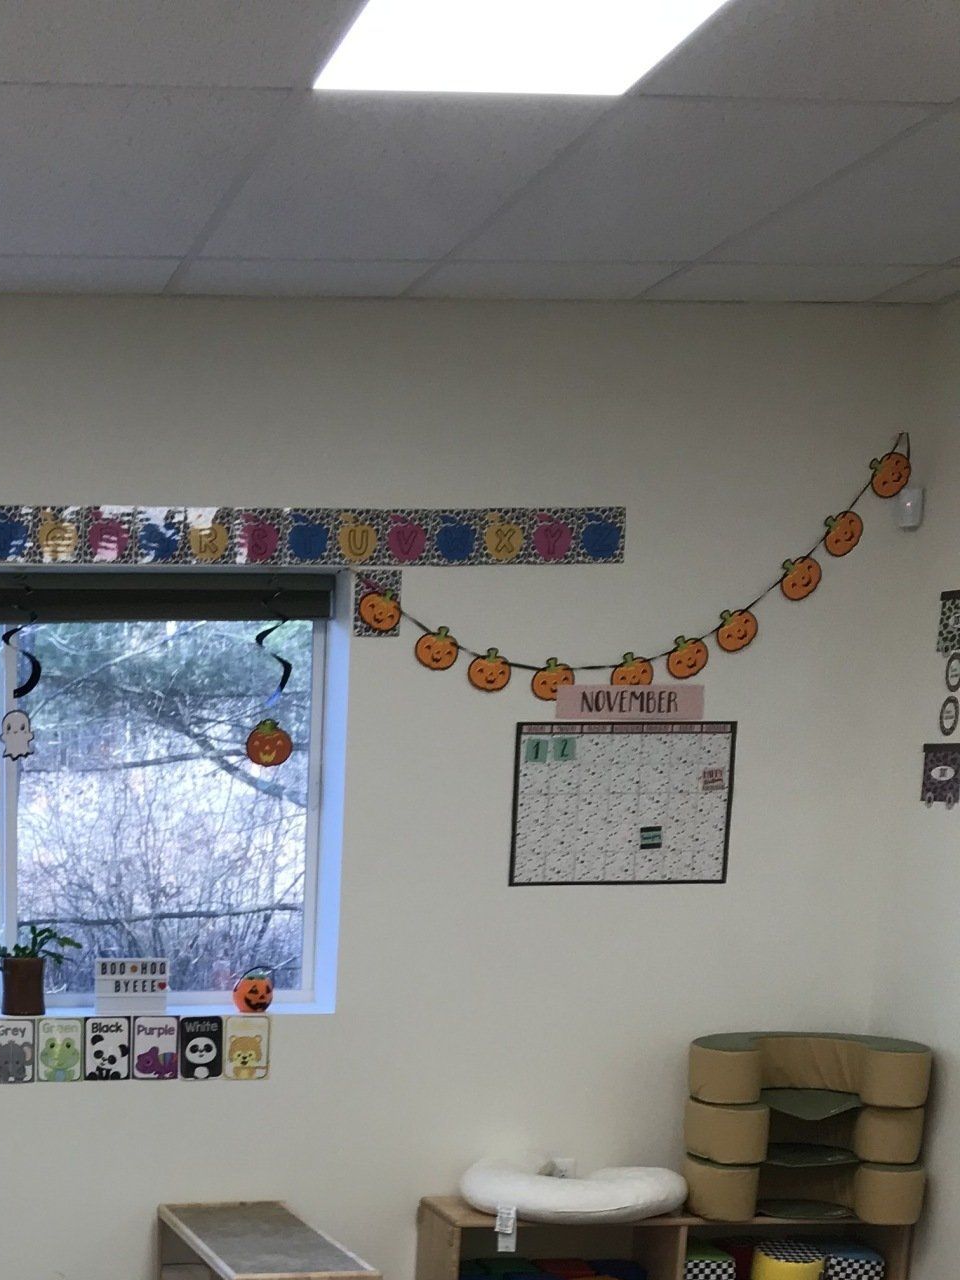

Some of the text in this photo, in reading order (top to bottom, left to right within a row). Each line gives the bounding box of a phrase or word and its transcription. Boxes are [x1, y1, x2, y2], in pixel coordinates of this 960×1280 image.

[198, 527, 218, 554] R
[251, 529, 268, 556] S
[348, 530, 368, 555] U
[397, 530, 417, 554] V
[494, 529, 515, 552] X
[543, 530, 562, 553] Y
[580, 690, 679, 713] NOVEMBER
[532, 739, 569, 760] 1 2
[100, 961, 166, 975] BOO HOO
[114, 980, 156, 993] BYEEE
[91, 1022, 123, 1034] Black
[137, 1024, 175, 1037] Purple
[185, 1020, 219, 1032] White
